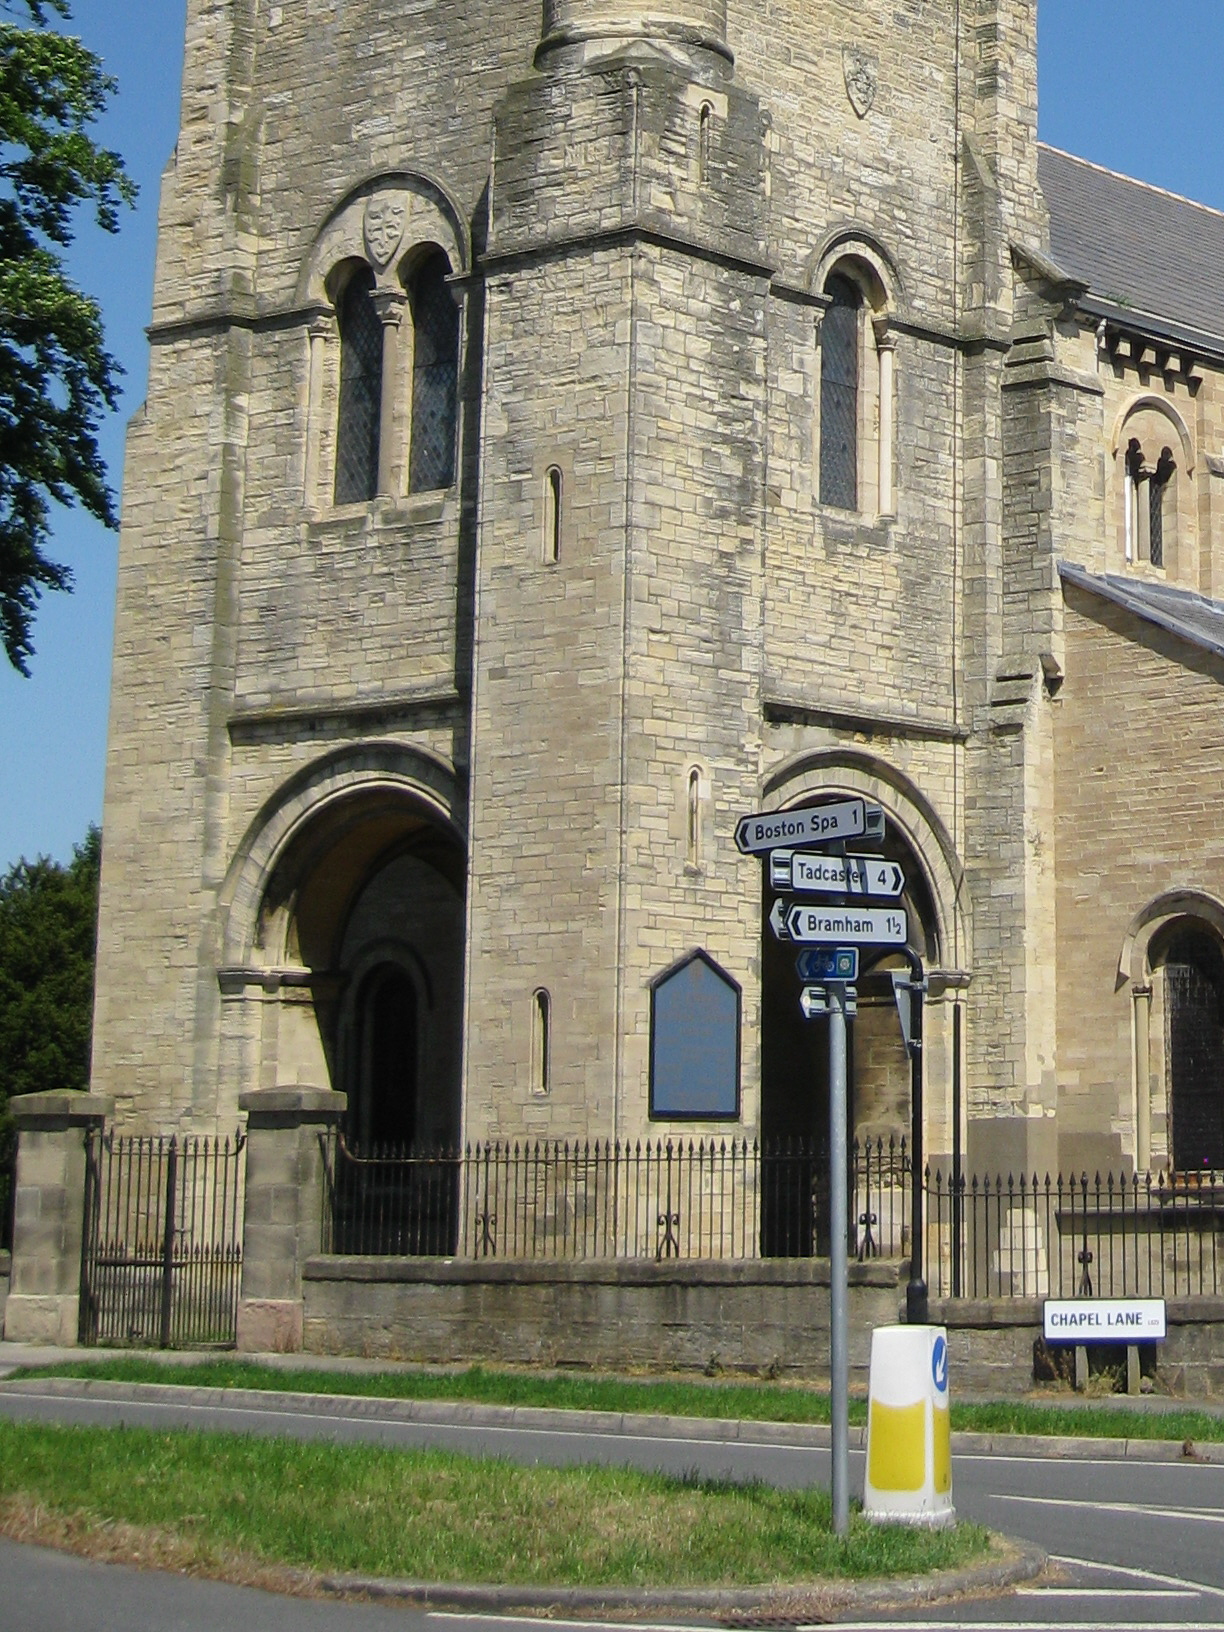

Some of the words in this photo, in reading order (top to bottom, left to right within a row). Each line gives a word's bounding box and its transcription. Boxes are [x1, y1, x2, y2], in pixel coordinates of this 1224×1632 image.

[755, 820, 805, 841] Boston
[810, 815, 838, 833] Spa
[852, 809, 859, 825] 1
[798, 862, 865, 884] Tadcaster
[877, 869, 887, 886] 4
[807, 914, 874, 933] Bramham
[1050, 1312, 1102, 1327] CHAPEL
[1107, 1312, 1143, 1326] LANE
